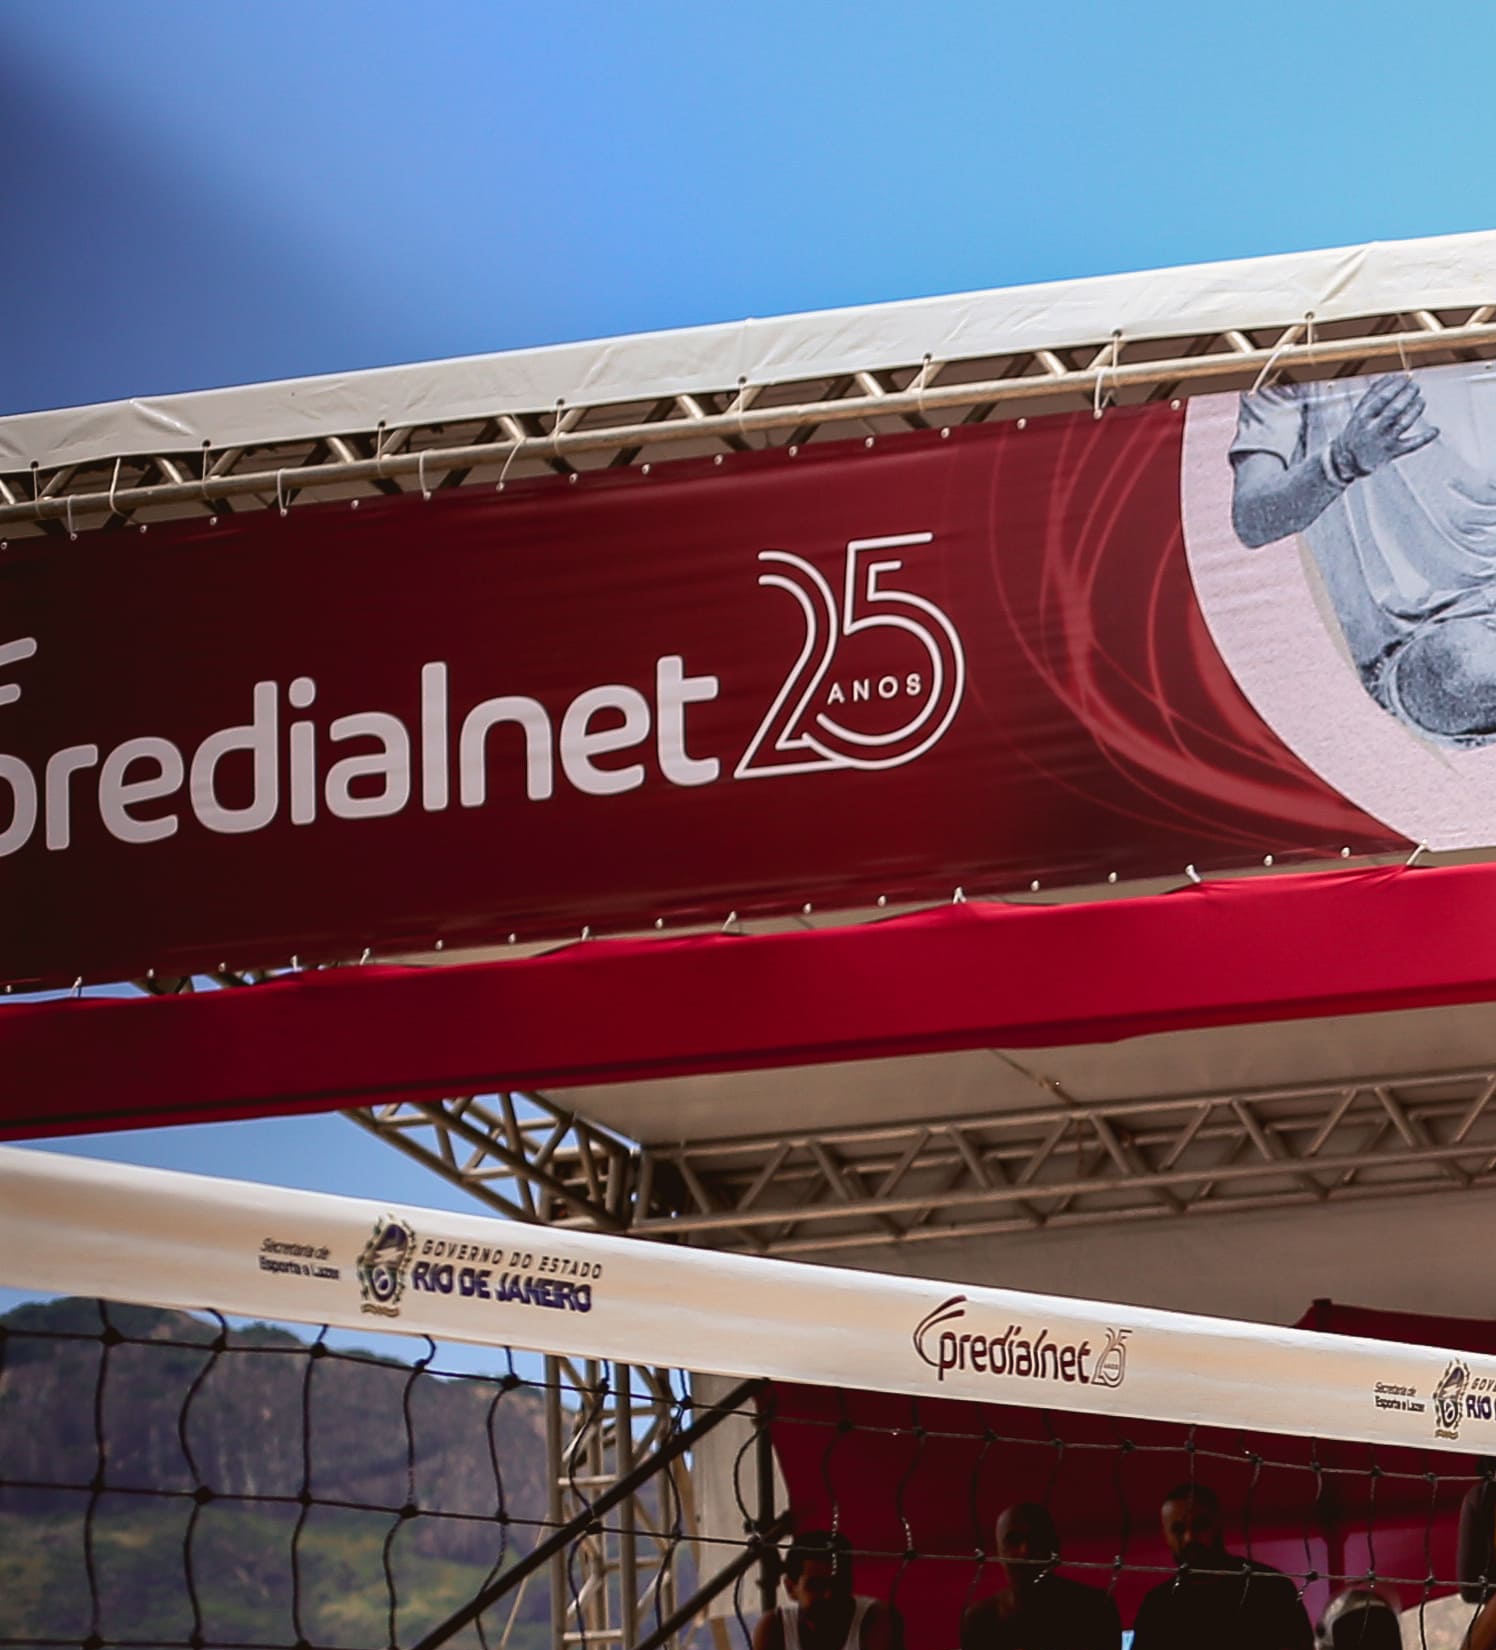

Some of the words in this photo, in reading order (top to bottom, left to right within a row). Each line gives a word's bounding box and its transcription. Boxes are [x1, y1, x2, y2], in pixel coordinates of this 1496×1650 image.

[733, 532, 965, 780] 25
[826, 672, 923, 706] ANOS
[421, 1239, 503, 1265] GOVERNO
[508, 1251, 533, 1269] DO
[537, 1256, 602, 1280] ESTADO
[411, 1260, 454, 1295] RIO
[458, 1267, 493, 1300] DE
[495, 1272, 593, 1313] JANEIRO
[937, 1324, 1092, 1384] predialnet
[1465, 1394, 1493, 1421] RIO
